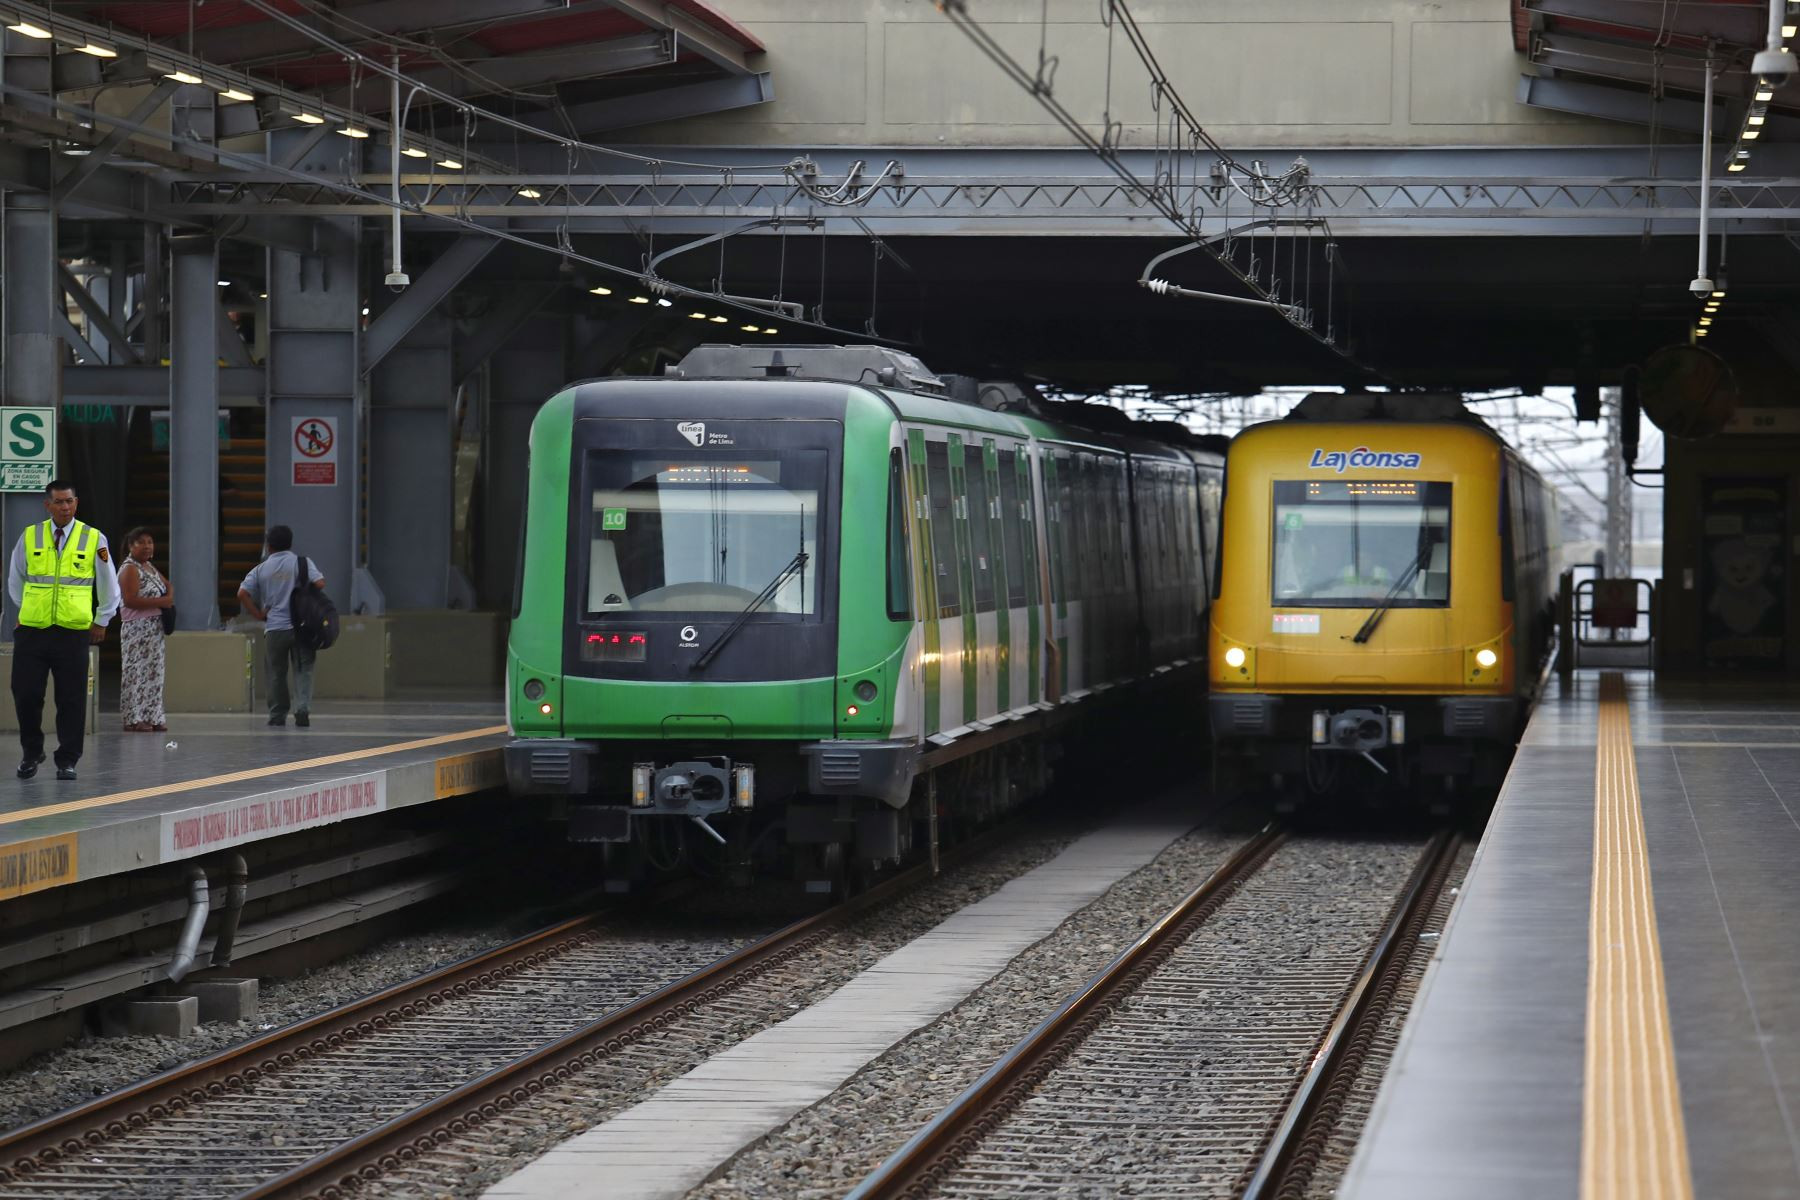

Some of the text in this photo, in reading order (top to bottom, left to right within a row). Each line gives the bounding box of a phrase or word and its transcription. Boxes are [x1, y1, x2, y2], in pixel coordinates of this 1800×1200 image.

[63, 402, 115, 424] ALIDA
[9, 413, 45, 457] S
[696, 433, 702, 444] 1
[606, 513, 624, 525] 10
